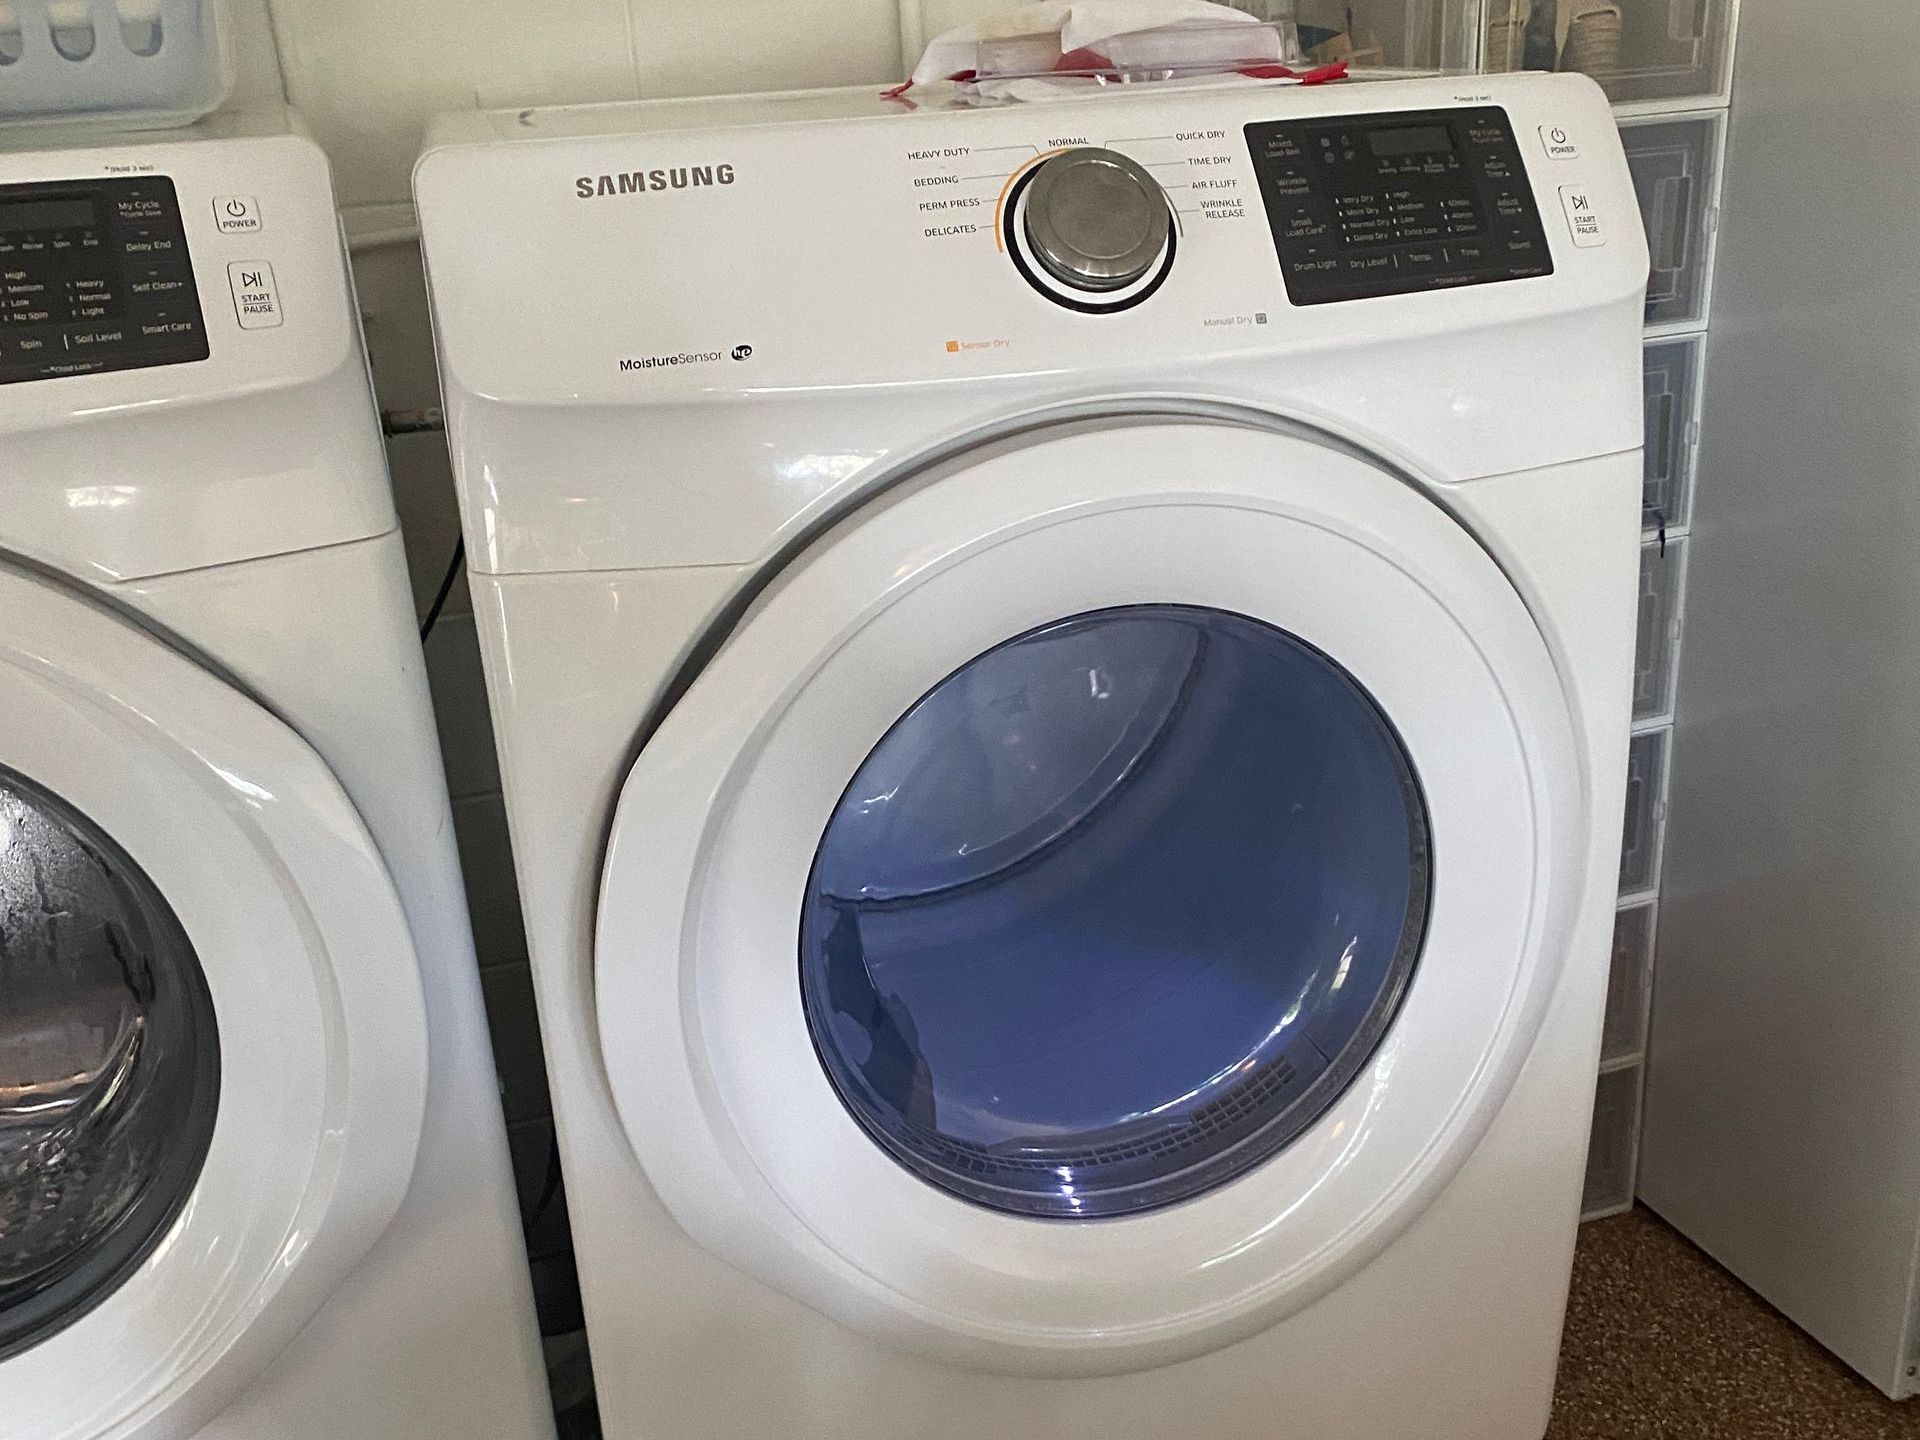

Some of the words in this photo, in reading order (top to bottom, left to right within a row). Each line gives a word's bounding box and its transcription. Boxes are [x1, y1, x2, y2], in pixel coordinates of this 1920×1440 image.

[1176, 132, 1205, 141] QUICK
[1206, 130, 1225, 139] DRY
[1048, 137, 1089, 147] NORMAL
[908, 150, 940, 160] HEAVY
[944, 148, 970, 156] DUTY
[1188, 156, 1211, 165] TIME
[1213, 156, 1232, 164] DRY
[576, 164, 734, 198] SAMSUNG
[914, 175, 959, 187] BEDDING
[1192, 181, 1207, 189] AIR
[1210, 180, 1237, 188] FLUFF
[118, 202, 132, 210] My
[135, 201, 160, 210] Cycle
[919, 201, 947, 211] PERM
[951, 198, 980, 207] PRESS
[1200, 199, 1243, 208] WRINKLE
[1206, 209, 1245, 218] RELEASE
[223, 220, 256, 229] POWER
[924, 224, 976, 237] DELICATES
[126, 243, 152, 251] Delay
[154, 240, 171, 249] End
[1294, 262, 1316, 271] Drum
[1317, 260, 1337, 270] Light
[1350, 260, 1365, 268] Dry
[152, 282, 177, 290] Clean
[242, 293, 270, 302] START
[244, 304, 274, 314] PAUSE
[1204, 317, 1234, 326] Manual
[1237, 316, 1252, 325] Dry
[142, 324, 169, 334] Smart
[172, 323, 192, 331] Care
[75, 335, 94, 344] Soil
[96, 332, 122, 342] Level
[20, 340, 42, 350] Spin
[961, 342, 990, 350] Sensor
[993, 340, 1010, 348] Dry
[620, 352, 722, 371] MoistureSensor
